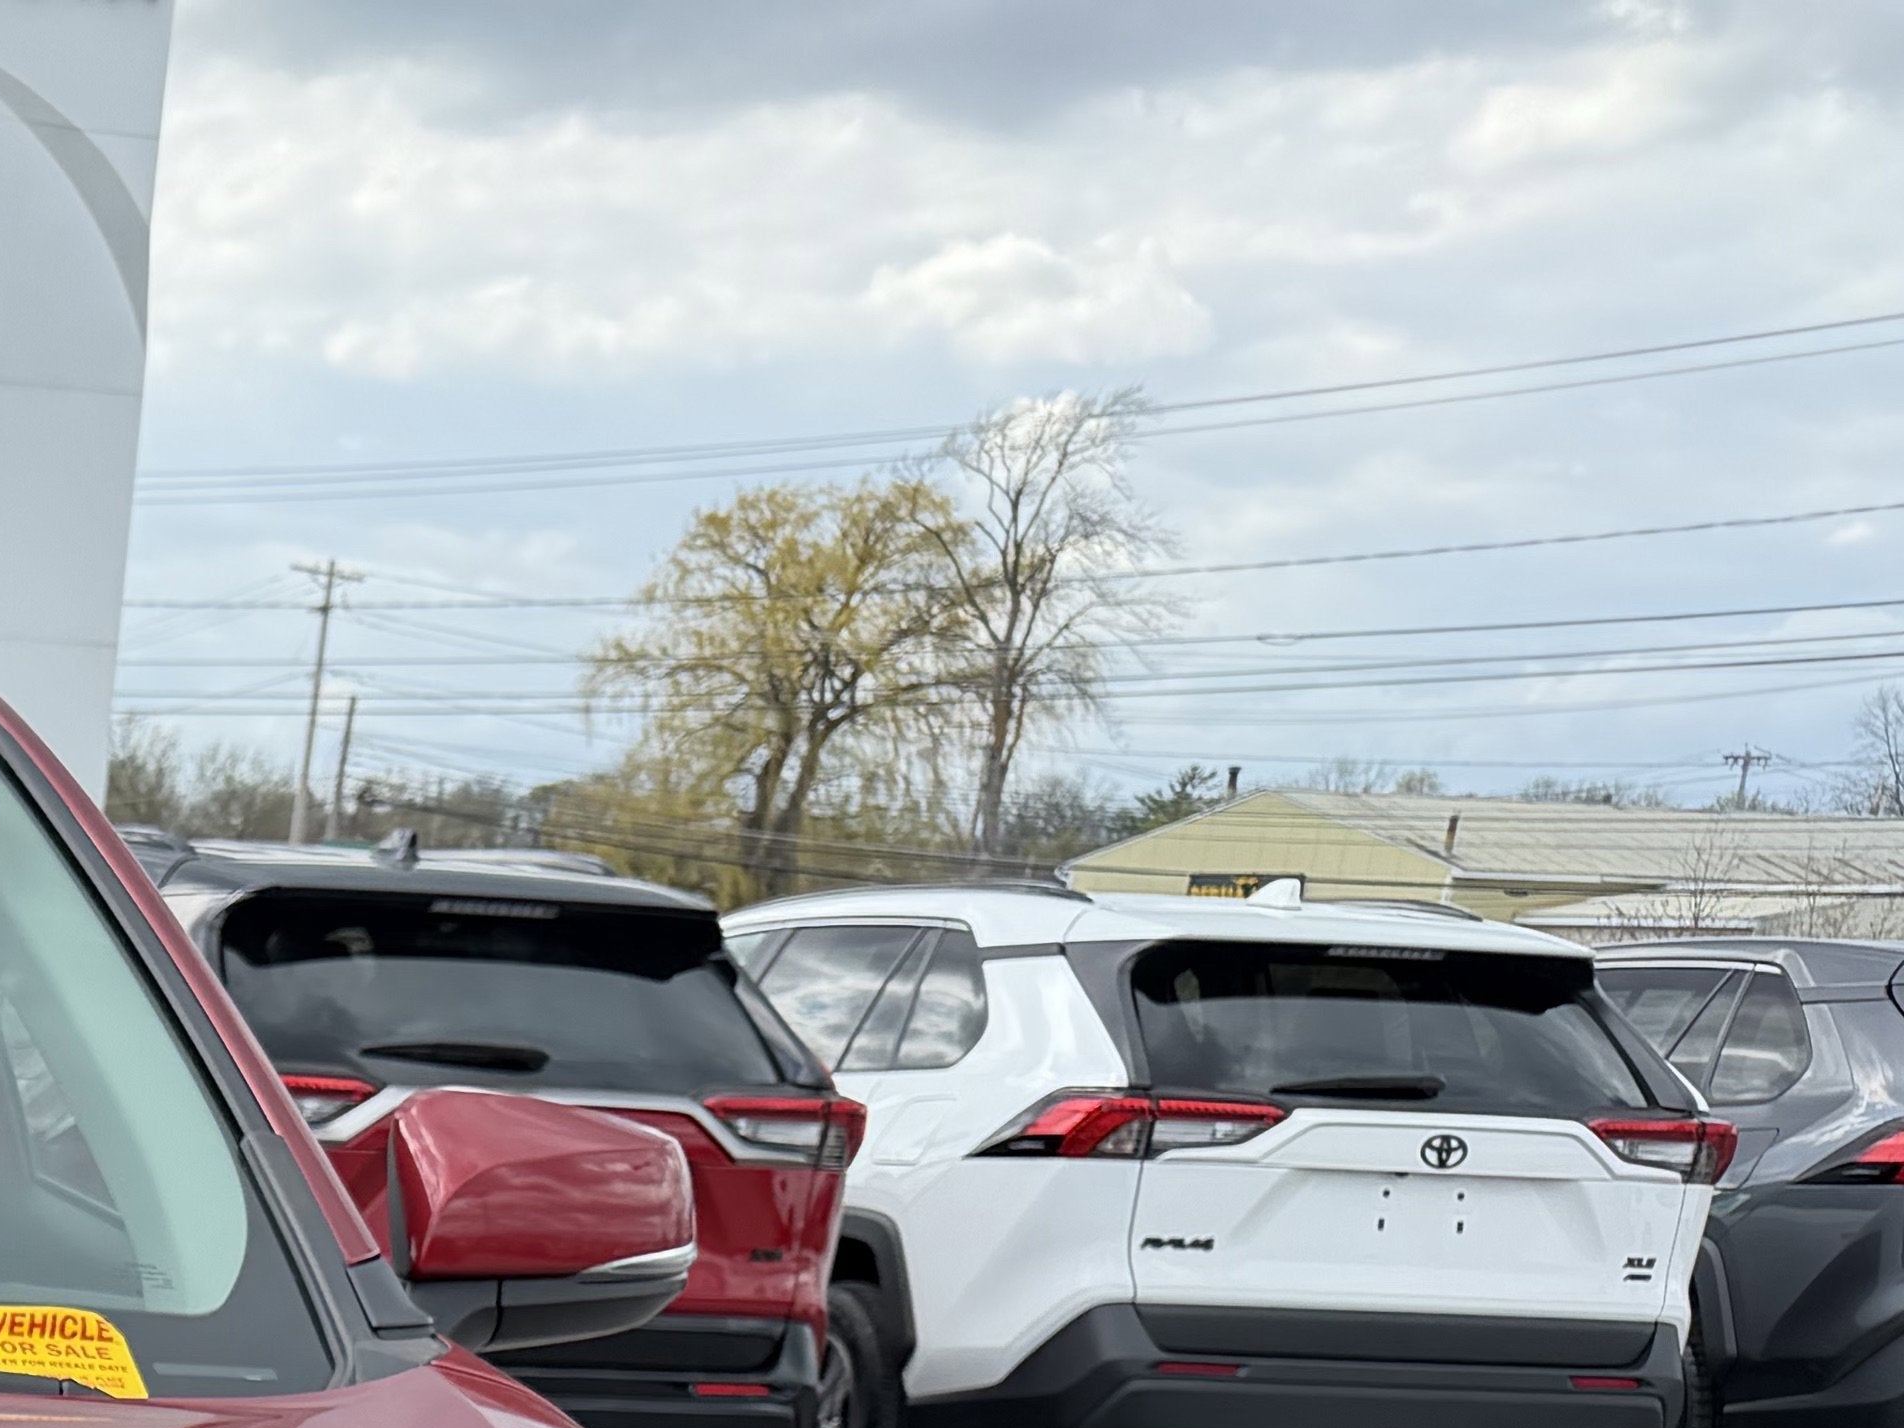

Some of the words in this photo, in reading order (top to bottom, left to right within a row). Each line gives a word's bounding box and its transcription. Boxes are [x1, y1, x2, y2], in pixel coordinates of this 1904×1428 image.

[47, 1343, 114, 1361] SALE
[21, 1359, 46, 1367] FOR
[99, 1363, 129, 1374] DATE
